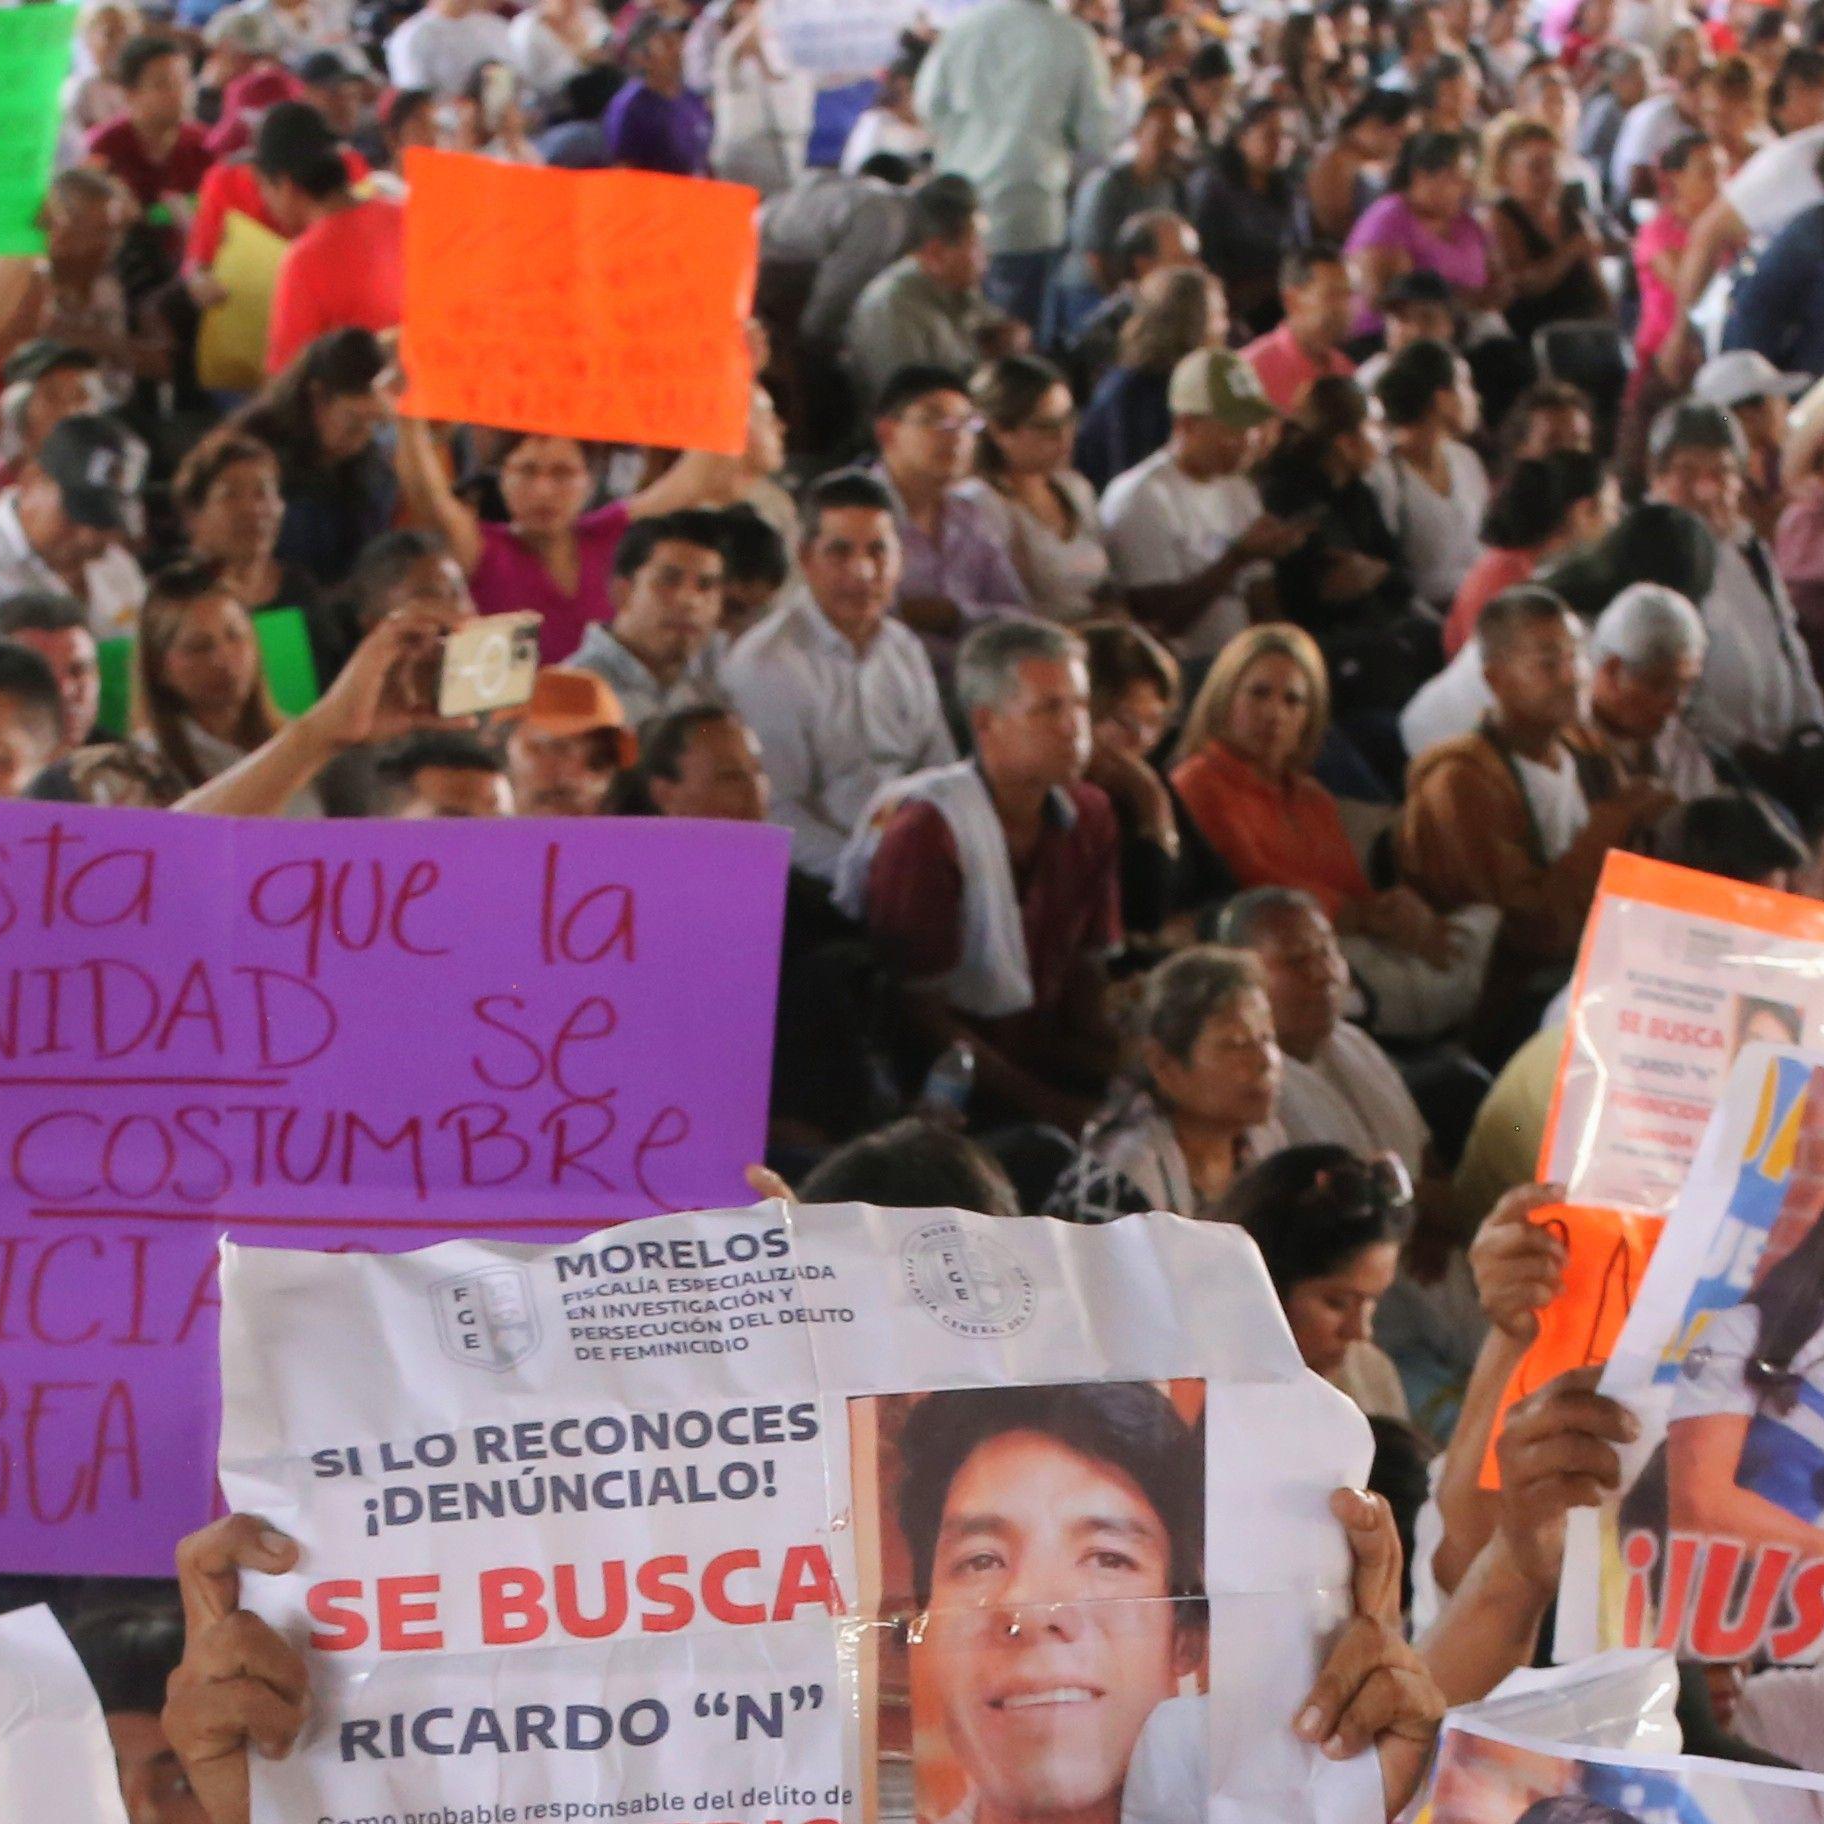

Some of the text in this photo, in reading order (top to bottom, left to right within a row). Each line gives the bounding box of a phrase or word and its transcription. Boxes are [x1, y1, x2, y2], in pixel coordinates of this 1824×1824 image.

[249, 857, 451, 978] que
[541, 842, 638, 965] la
[554, 1227, 791, 1283] MORELOS
[562, 1264, 836, 1306] FISCALÍA ESPECIALIZADA
[566, 1287, 794, 1321] EN INVESTIGACIÓN Y
[570, 1305, 855, 1342] PERSECUCIÓN DEL DELITO
[574, 1335, 750, 1362] DE FEMINICIDIO
[311, 1402, 819, 1479] SI LO RECONOCES
[363, 1459, 778, 1537] ¡DENÚNCIALO!
[306, 1543, 847, 1653] SE BUSCA
[339, 1698, 670, 1762] RICARDO
[523, 1791, 685, 1822] responsable
[693, 1789, 736, 1811] del
[741, 1784, 817, 1809] delito
[824, 1784, 853, 1805] de
